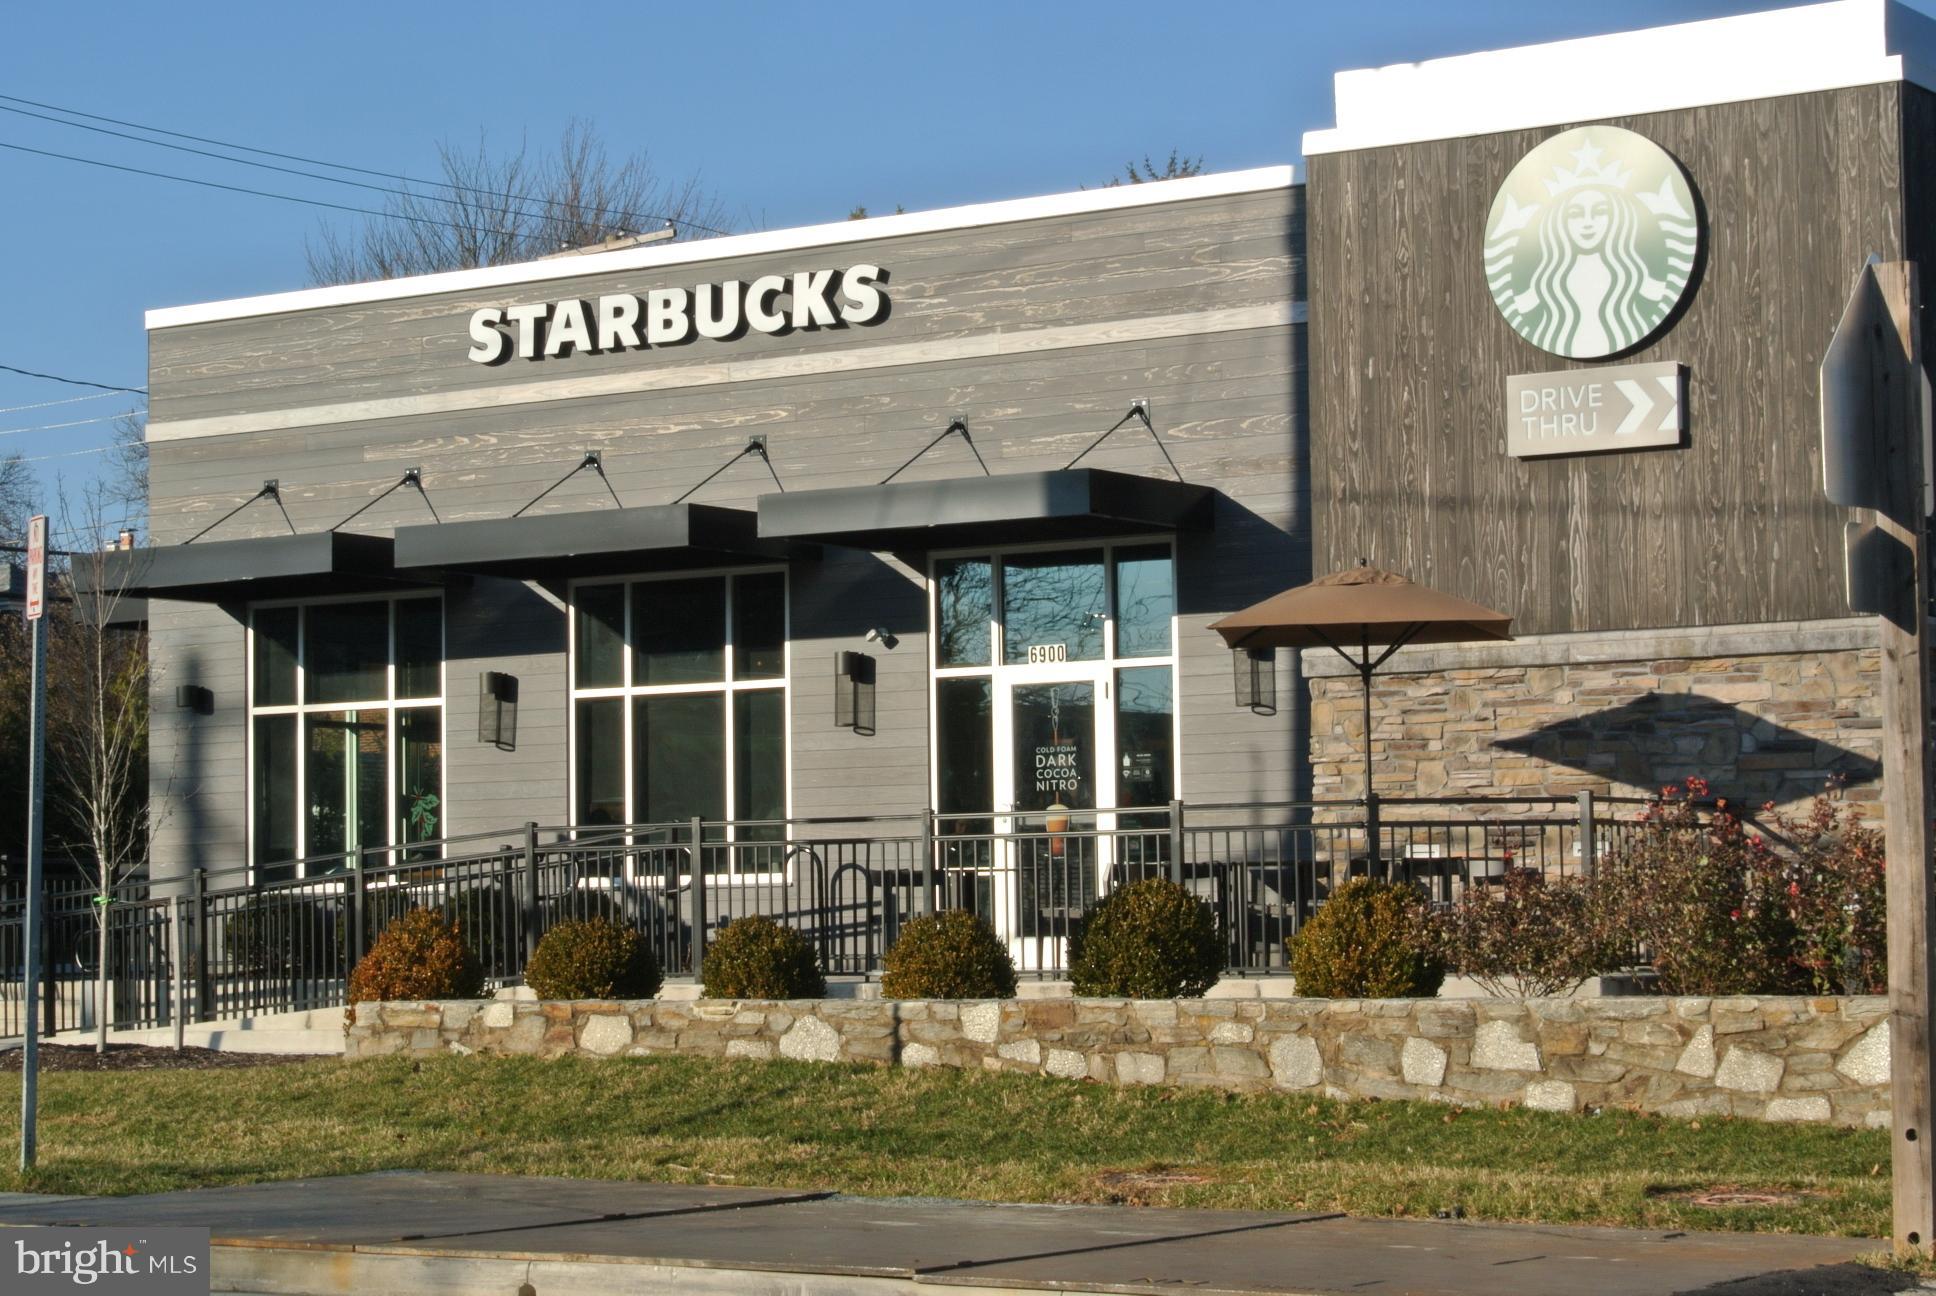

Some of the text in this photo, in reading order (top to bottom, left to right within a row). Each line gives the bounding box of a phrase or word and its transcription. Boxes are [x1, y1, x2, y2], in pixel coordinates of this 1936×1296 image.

[468, 264, 882, 364] STARBUCKS
[1520, 384, 1603, 413] DRIVE
[1521, 411, 1597, 440] THRU
[1030, 645, 1065, 663] 6900
[1035, 753, 1077, 768] DARK
[1036, 768, 1077, 779] COCOA
[1036, 779, 1078, 791] NITRO
